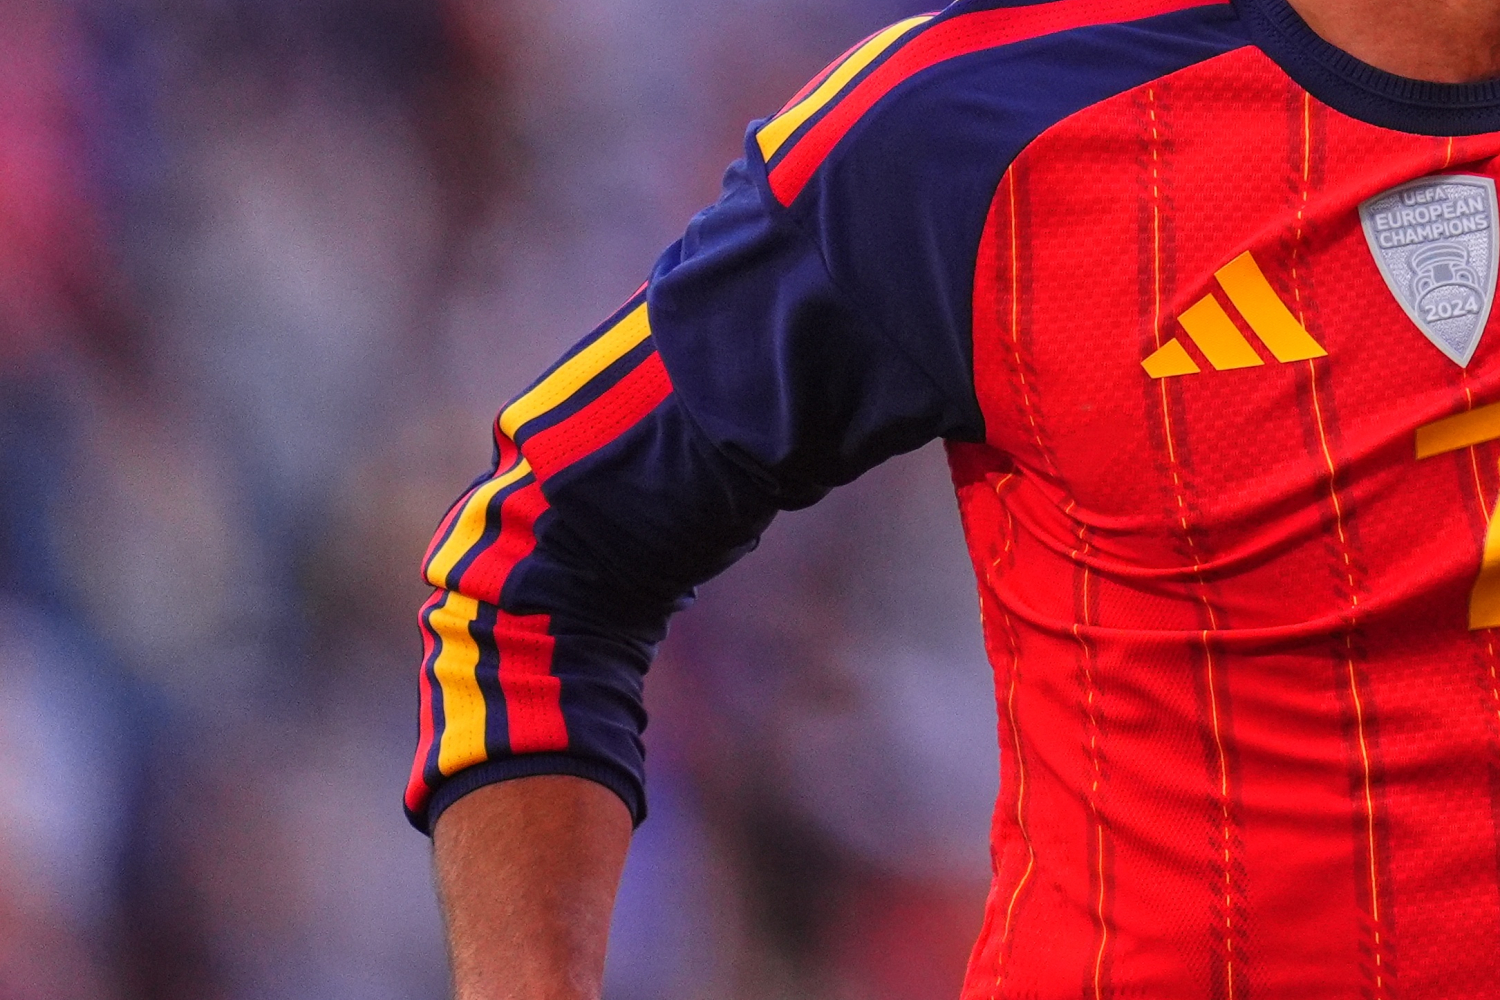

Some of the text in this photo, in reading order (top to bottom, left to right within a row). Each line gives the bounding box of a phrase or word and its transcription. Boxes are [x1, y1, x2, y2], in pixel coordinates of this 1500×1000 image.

[1403, 187, 1446, 206] UEFA
[1375, 197, 1484, 230] EUROPEAN
[1379, 214, 1488, 248] CHAMPIONS
[1425, 296, 1478, 322] 2024
